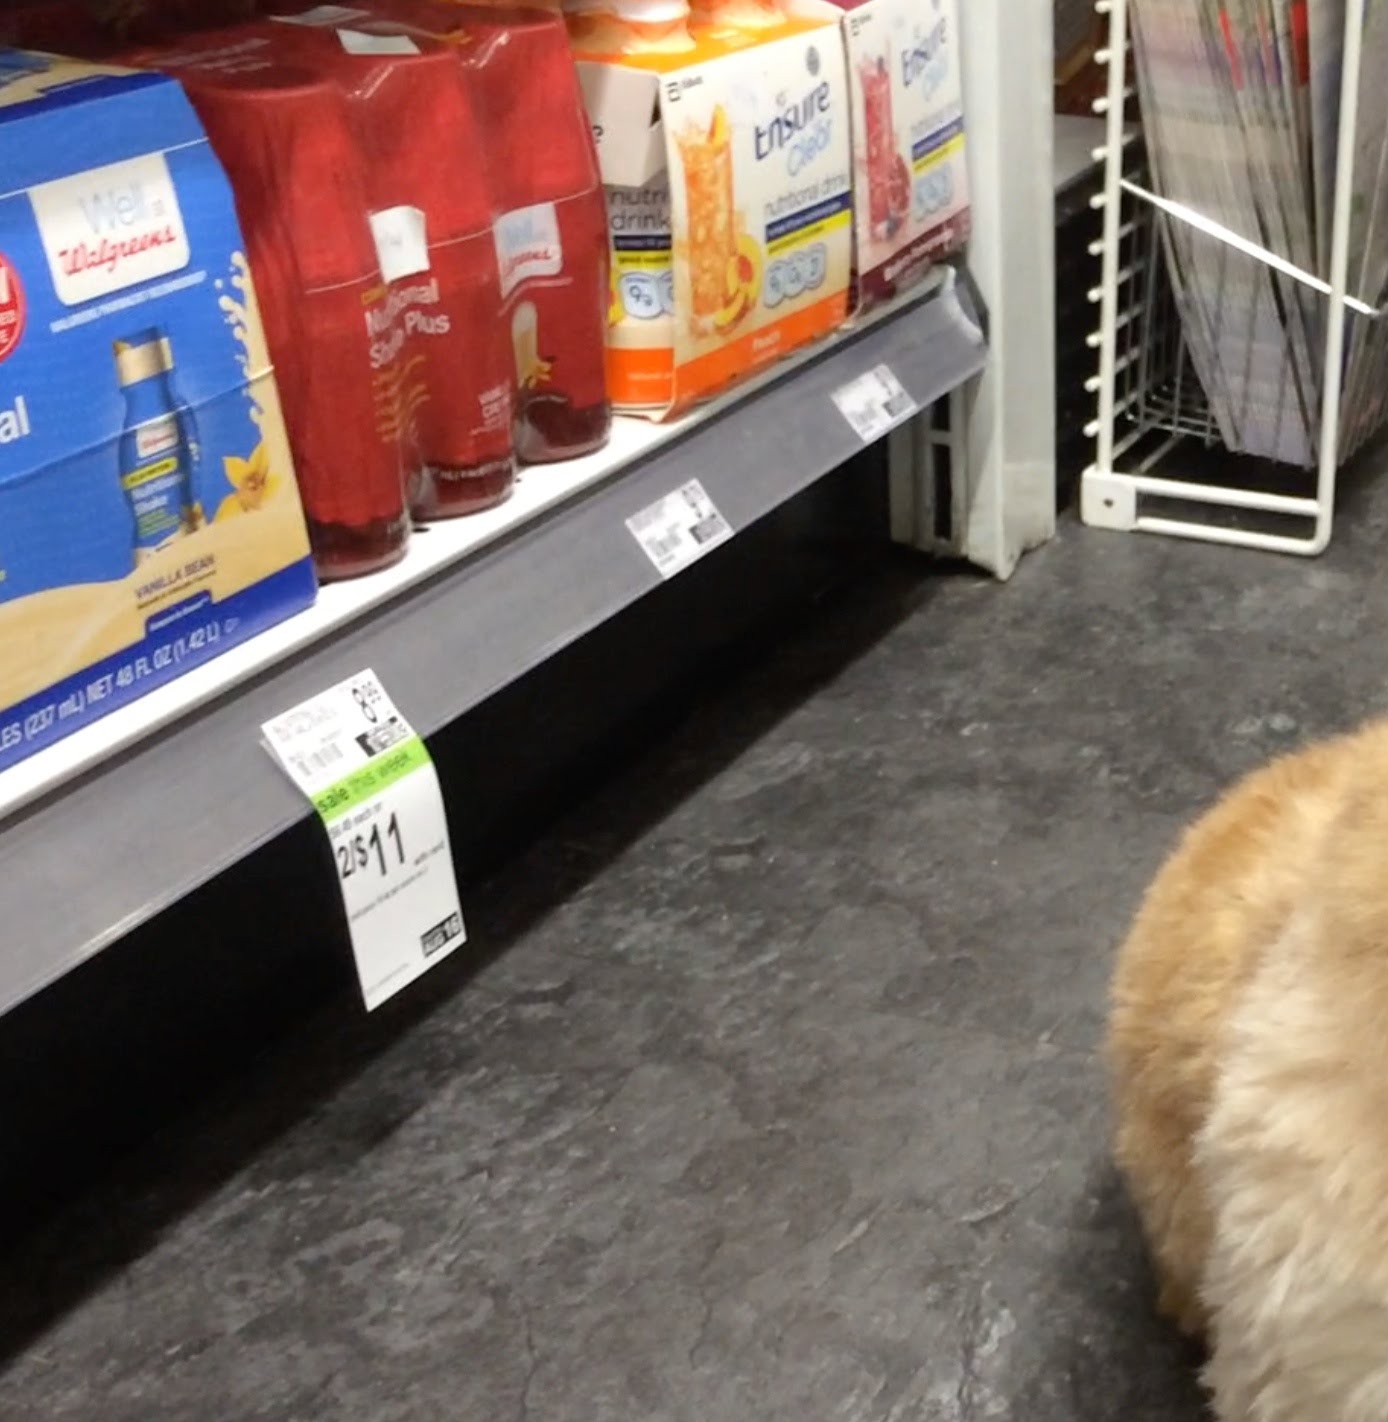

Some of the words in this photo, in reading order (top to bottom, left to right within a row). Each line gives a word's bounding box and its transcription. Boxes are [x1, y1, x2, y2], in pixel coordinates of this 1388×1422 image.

[58, 225, 177, 276] Walgreens
[404, 310, 451, 336] Plus
[0, 722, 22, 752] ES
[24, 704, 56, 741] (237
[86, 672, 114, 703] NET
[116, 664, 134, 689] 48
[135, 655, 152, 680] FL
[152, 644, 174, 669] OZ
[317, 787, 350, 813] sale
